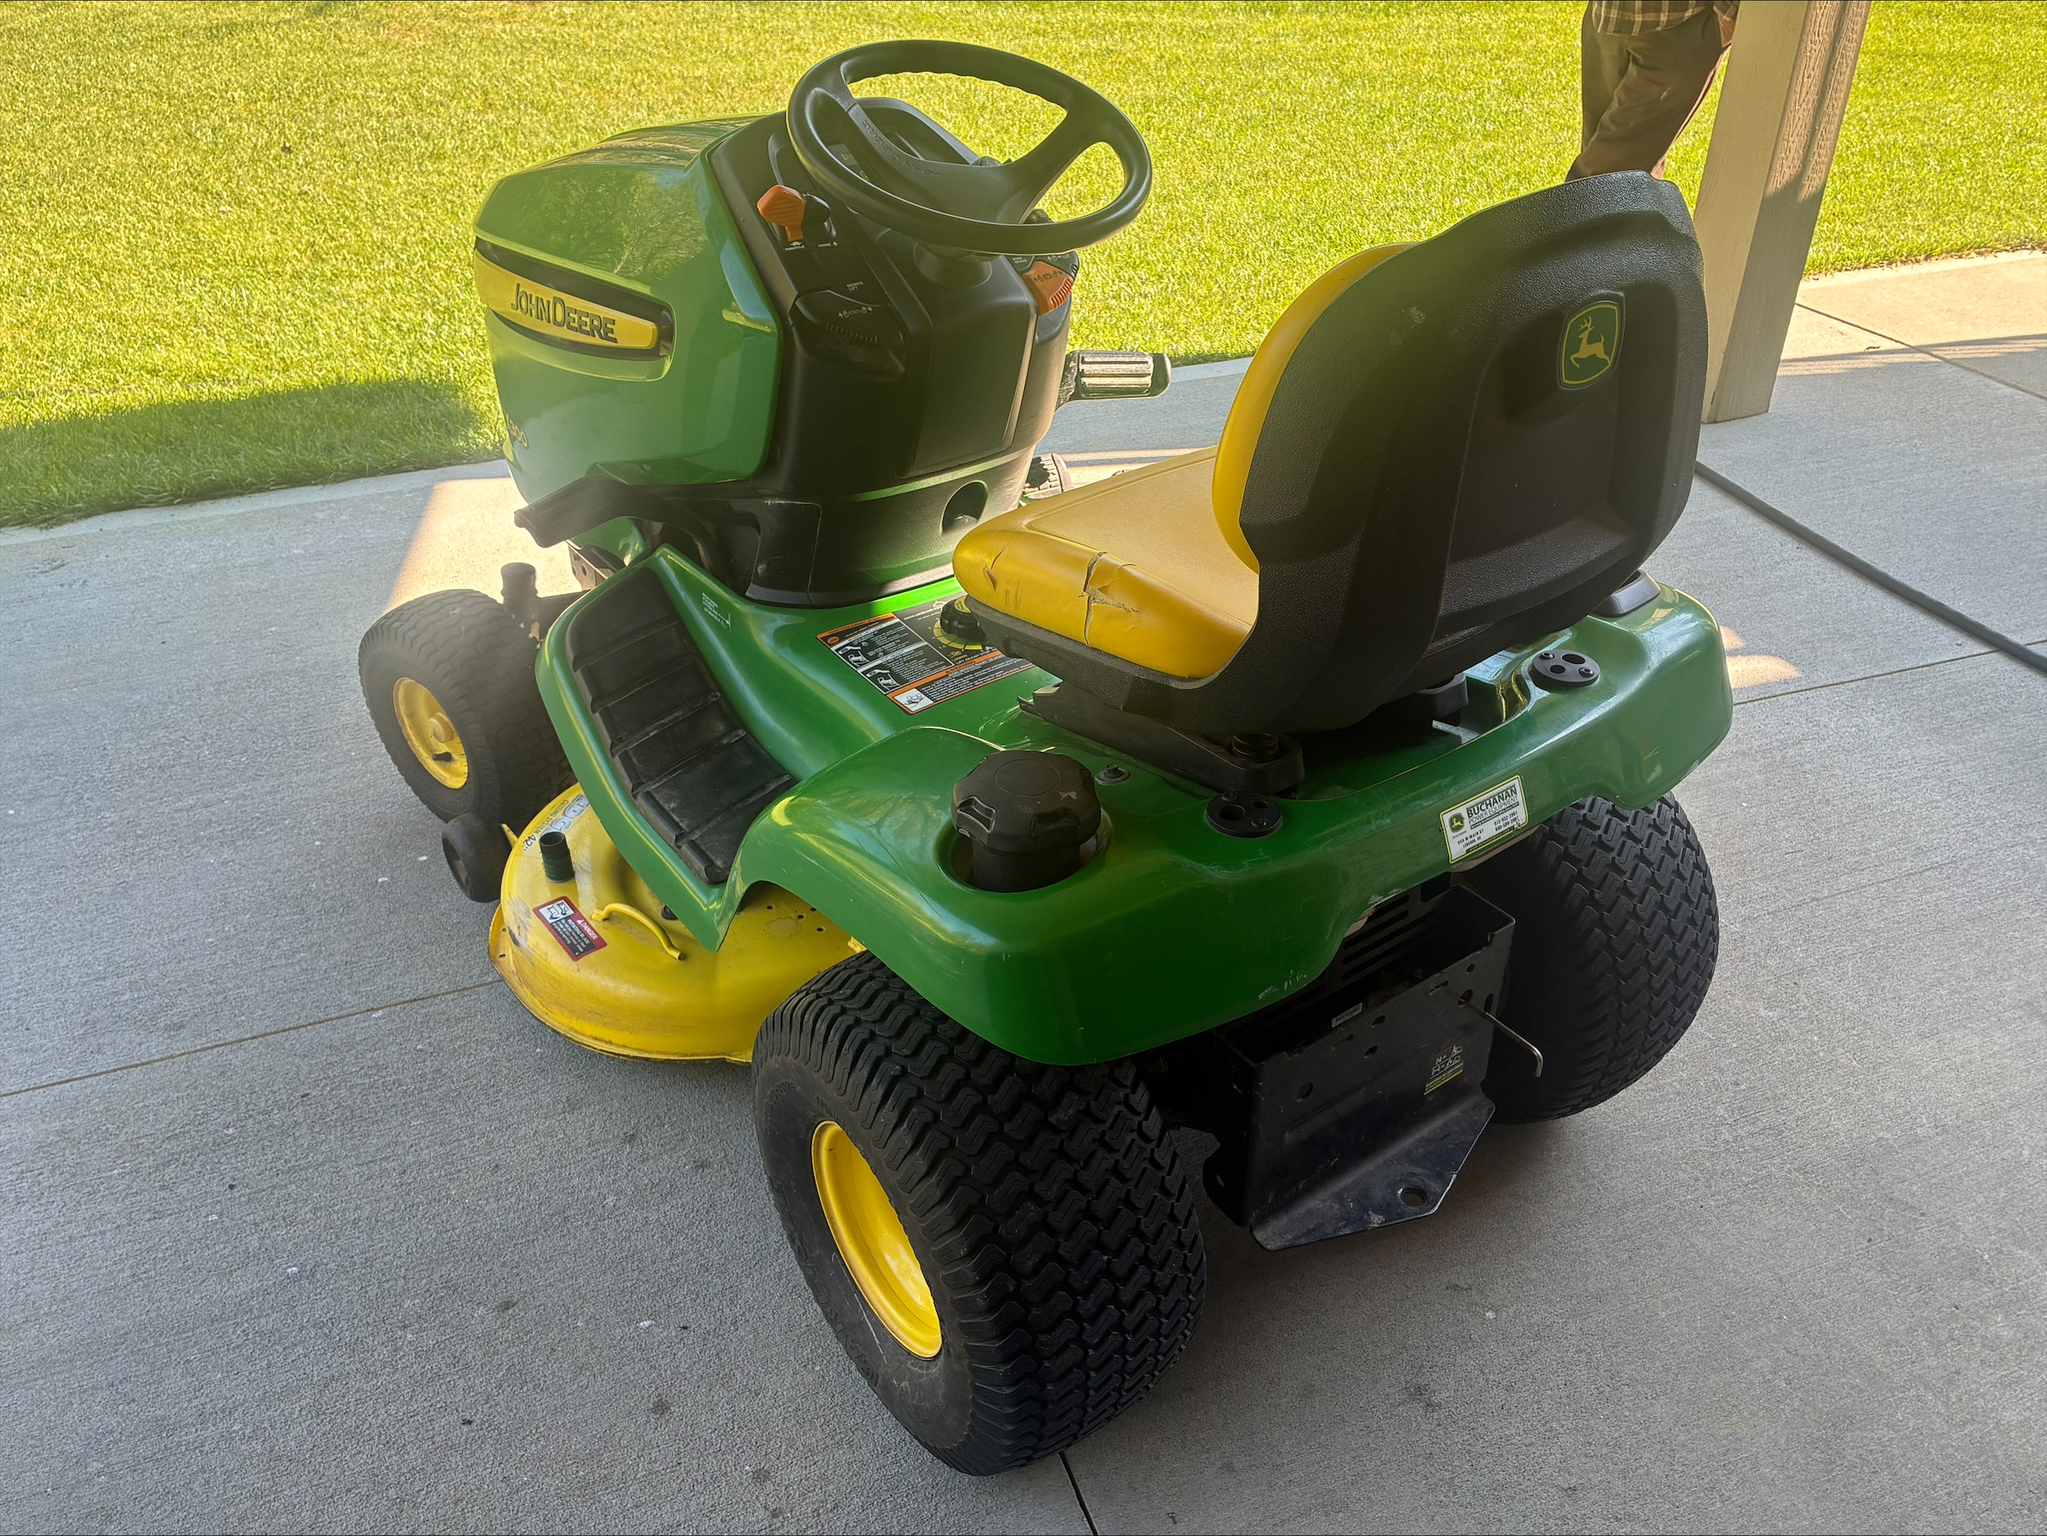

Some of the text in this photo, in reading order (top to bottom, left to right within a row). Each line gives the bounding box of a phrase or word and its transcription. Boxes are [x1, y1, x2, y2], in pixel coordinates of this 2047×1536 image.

[511, 283, 618, 344] JOHN DEERE
[541, 795, 590, 836] EDG
[552, 799, 569, 818] CUTTING
[1466, 787, 1517, 819] BUCHANAN
[1468, 809, 1488, 825] POWER
[1488, 795, 1518, 815] EQUIPMENT
[523, 834, 537, 852] 42"
[580, 921, 598, 940] DANGER
